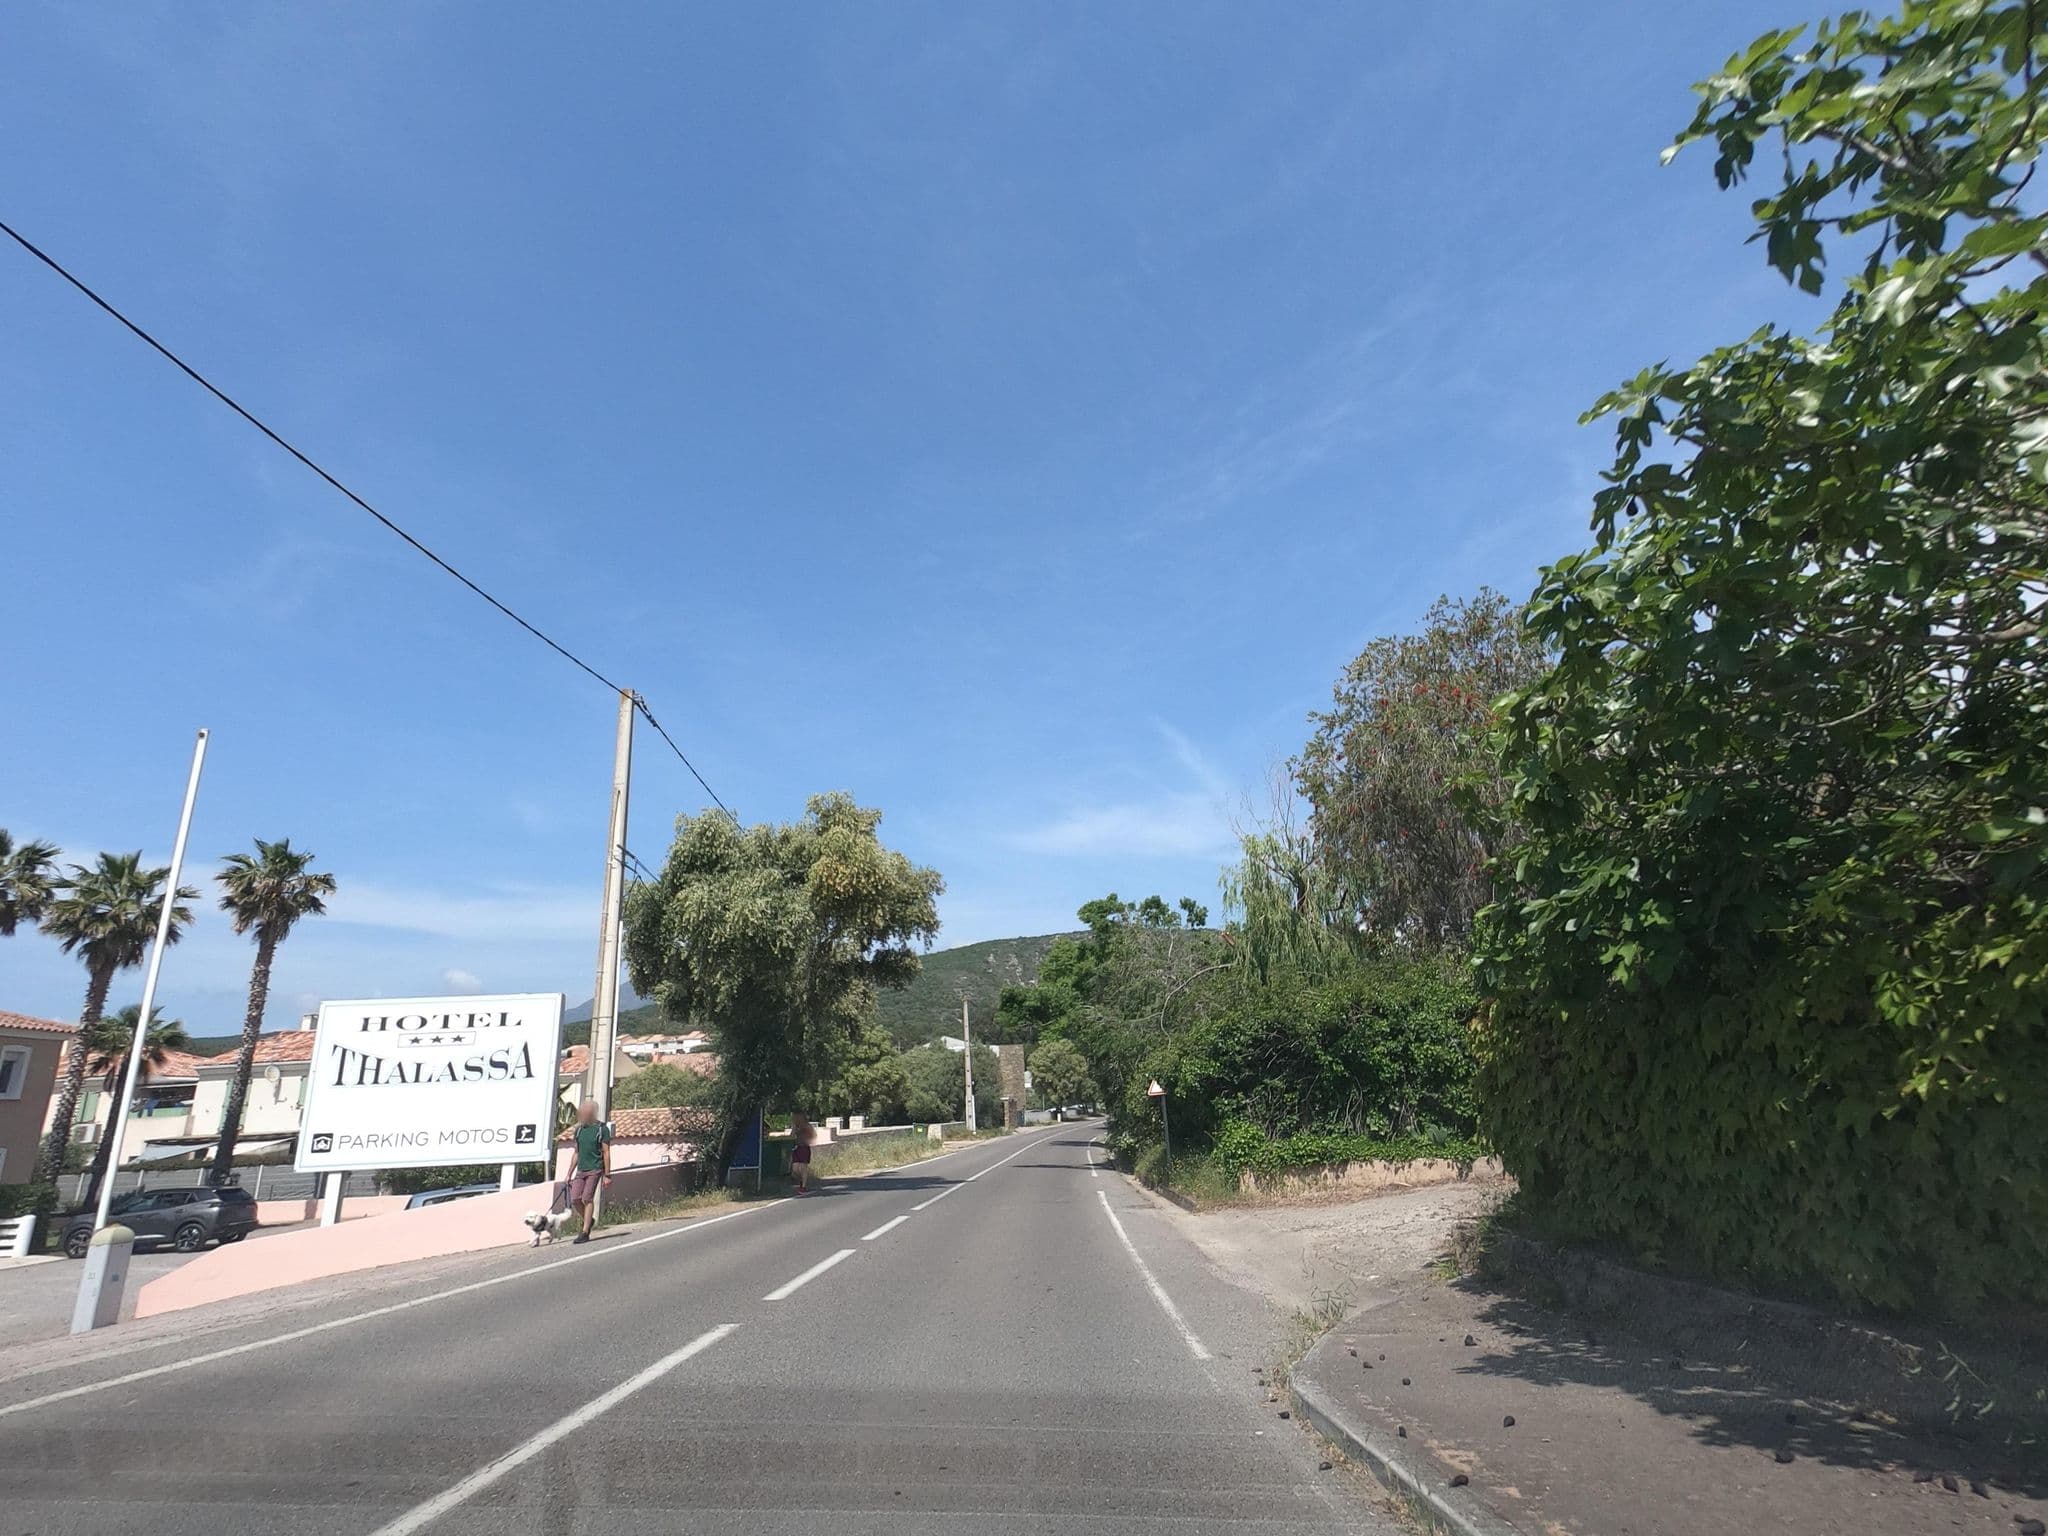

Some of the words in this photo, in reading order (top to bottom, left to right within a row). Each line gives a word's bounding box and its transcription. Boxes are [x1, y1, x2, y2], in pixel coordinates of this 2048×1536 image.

[360, 1012, 522, 1032] HOTEL
[331, 1040, 535, 1086] THALASSA
[338, 1131, 429, 1150] PARKING
[438, 1128, 509, 1145] MOTOS
